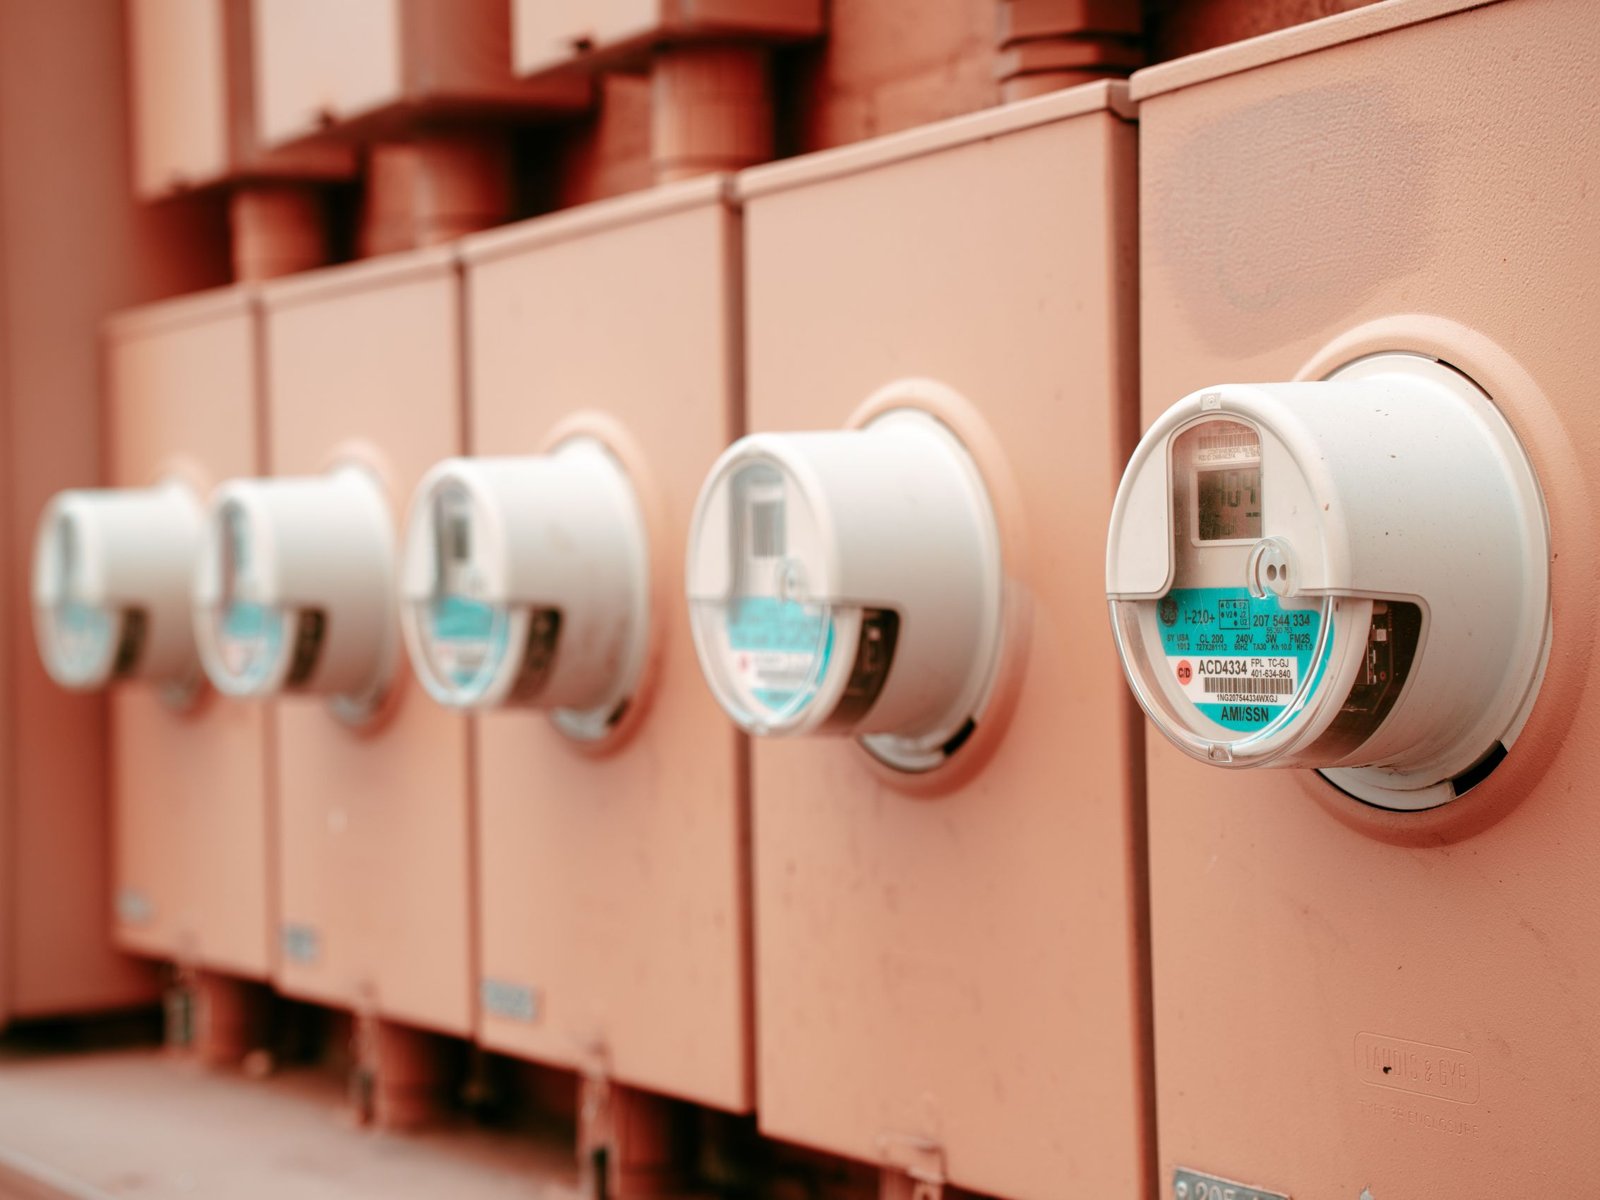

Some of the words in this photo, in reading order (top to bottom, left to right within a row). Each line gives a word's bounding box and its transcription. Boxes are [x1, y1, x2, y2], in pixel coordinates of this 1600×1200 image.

[1184, 609, 1215, 624] I-210+
[1253, 614, 1270, 627] 207
[1272, 614, 1290, 627] 544
[1293, 613, 1310, 627] 334
[1199, 633, 1210, 644] CL
[1211, 633, 1224, 644] 200
[1235, 633, 1254, 644] 240V
[1265, 633, 1277, 644] 3W
[1198, 659, 1248, 675] ACD4334
[1251, 658, 1264, 668] FPL
[1268, 658, 1289, 669] TC-GJ
[1251, 669, 1291, 679] 401-634-840
[1221, 705, 1269, 723] AMI/SSN
[1424, 1059, 1433, 1083] &
